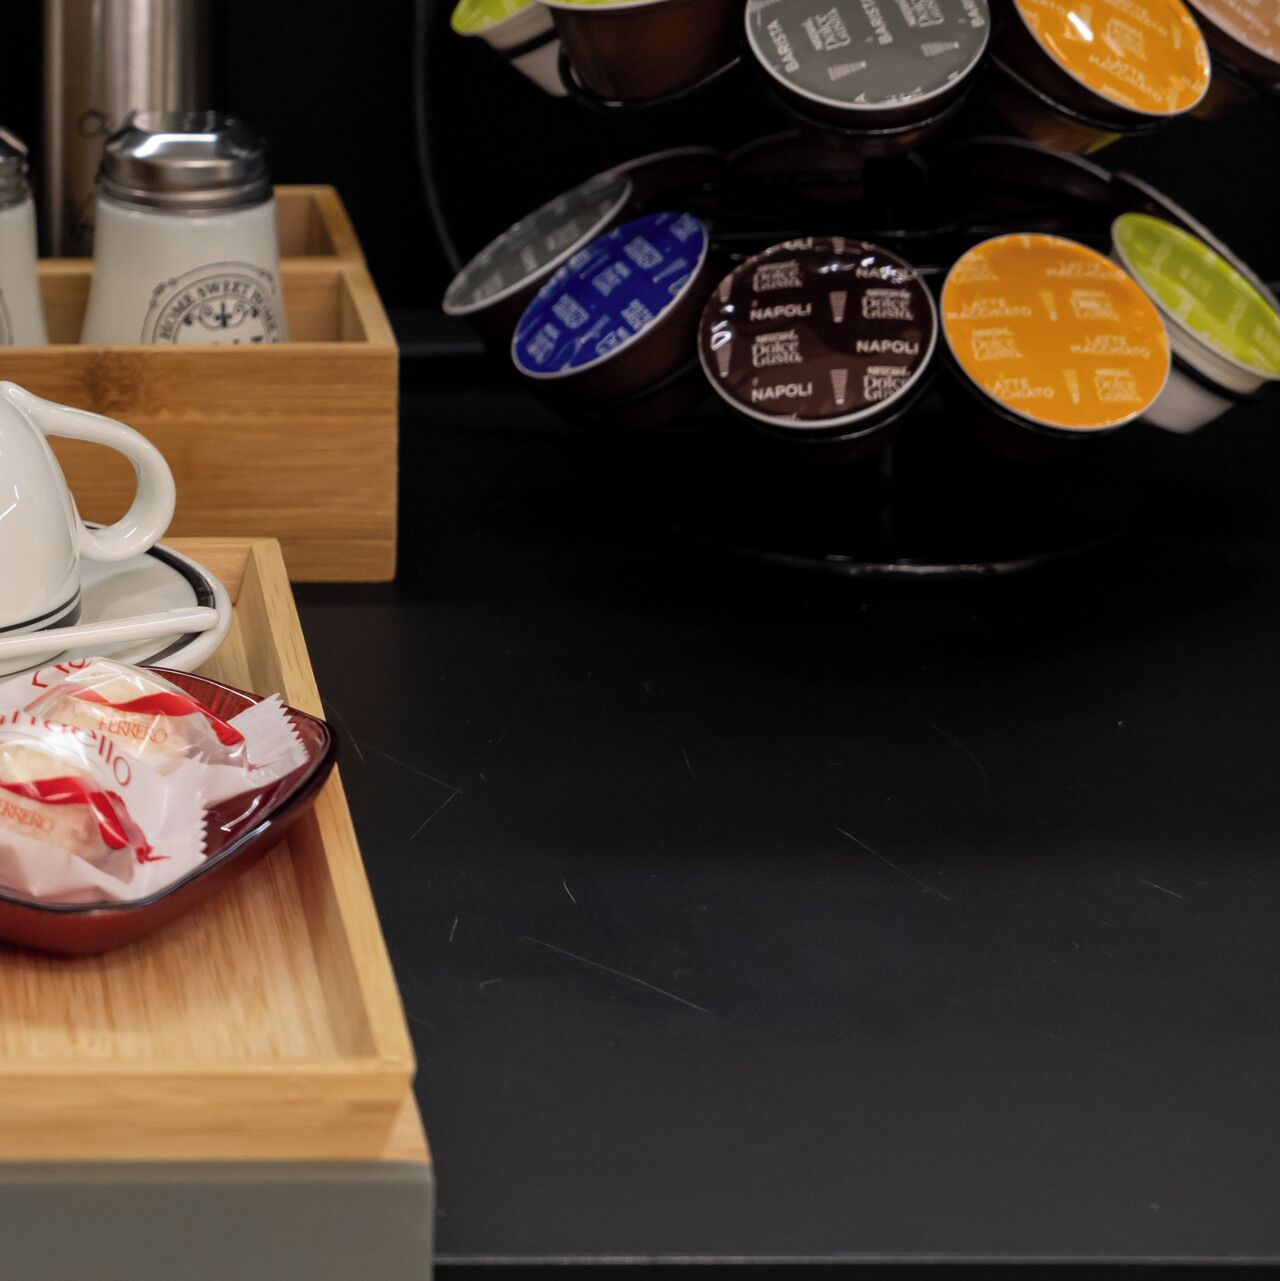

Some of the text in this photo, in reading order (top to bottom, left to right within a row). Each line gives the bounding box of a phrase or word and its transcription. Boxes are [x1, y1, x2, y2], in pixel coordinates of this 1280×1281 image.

[767, 19, 799, 73] BARISTA
[750, 302, 812, 321] NAPOLI
[856, 339, 920, 355] NAPOLI
[751, 382, 814, 402] NAPOLI
[98, 716, 170, 745] FERRERO
